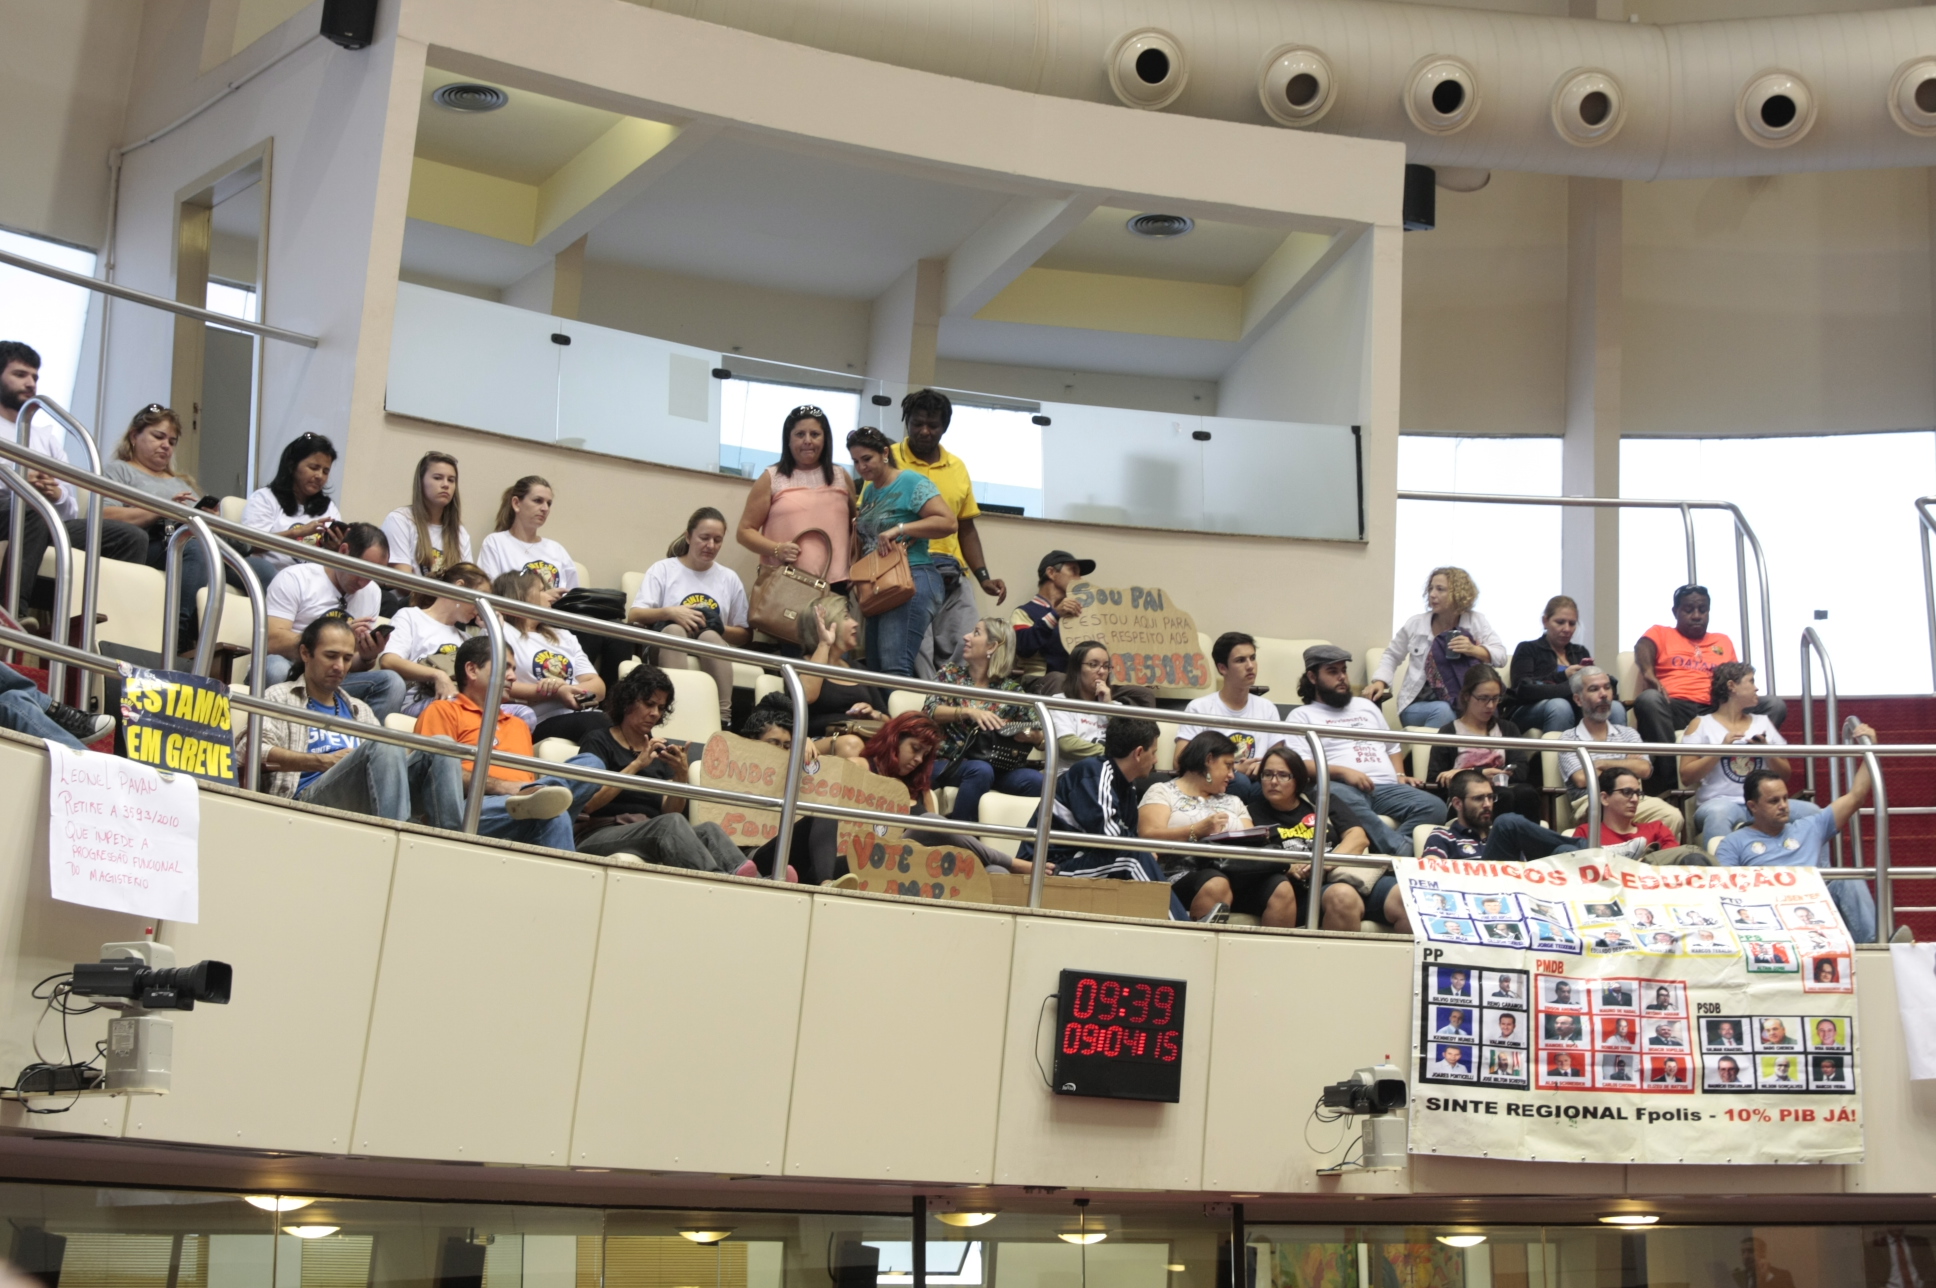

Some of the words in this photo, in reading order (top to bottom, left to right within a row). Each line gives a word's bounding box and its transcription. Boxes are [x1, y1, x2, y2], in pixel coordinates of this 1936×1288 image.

[1072, 582, 1123, 608] SOU
[1131, 586, 1164, 612] PAI
[1079, 613, 1128, 627] ESTOU
[1134, 615, 1158, 630] AQUI
[1164, 616, 1192, 631] PARA
[1065, 632, 1109, 647] PEDIR
[1111, 630, 1164, 645] RESPEITO
[1170, 631, 1189, 645] AOS
[1109, 653, 1207, 687] OFESSORES
[126, 677, 231, 731] ESTAMOS
[127, 725, 163, 764] EM
[165, 733, 234, 779] GREVE
[703, 734, 777, 787] ONDE
[60, 750, 112, 790] LEONEL
[118, 770, 158, 795] PAVAN
[58, 790, 103, 816] RETIRE
[110, 805, 118, 818] A
[123, 806, 180, 828] 3593/2010
[65, 820, 88, 843] QUE
[141, 838, 149, 850] A
[65, 861, 81, 876] DO
[133, 856, 184, 874] FUNCIONAL
[853, 831, 914, 874] VOTE
[926, 849, 975, 880] COM
[1408, 878, 1439, 888] DEM
[1418, 857, 1568, 887] INIMIGOS
[1578, 863, 1619, 884] DA
[1620, 868, 1797, 893] EDUCAÇÃO
[1423, 947, 1444, 961] PP
[1536, 959, 1564, 974] PMDB
[1073, 978, 1175, 1025] 09:39
[1697, 1002, 1721, 1014] PSDB
[1425, 1097, 1498, 1115] SINTE
[1506, 1102, 1629, 1121] REGIONAL
[1636, 1107, 1702, 1124] Fpolis
[1724, 1107, 1772, 1123] 10%
[1779, 1108, 1816, 1122] PIB
[1823, 1105, 1857, 1122] JÁ!
